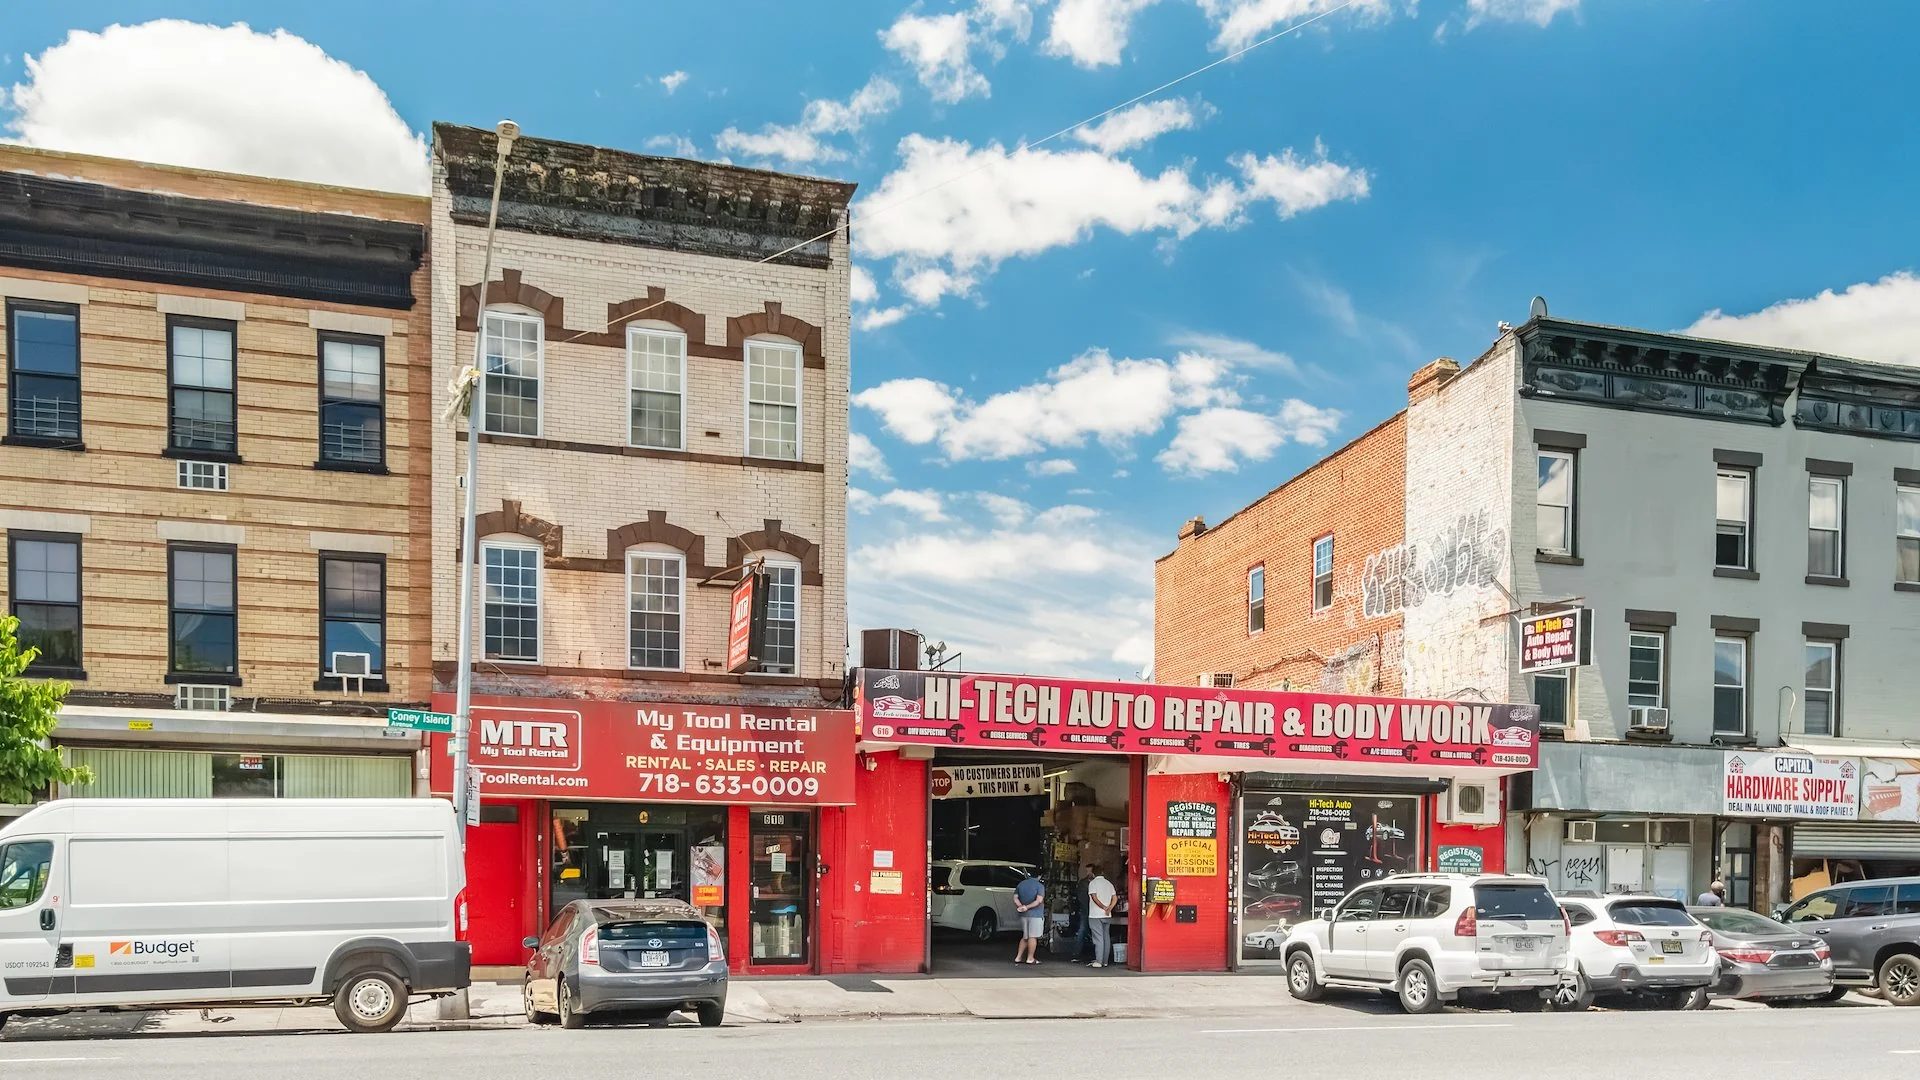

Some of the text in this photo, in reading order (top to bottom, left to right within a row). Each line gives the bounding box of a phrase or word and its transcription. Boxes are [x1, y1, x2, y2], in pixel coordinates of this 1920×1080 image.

[735, 595, 749, 624] MTR
[1526, 629, 1571, 647] Auto Repair
[1524, 642, 1573, 661] & Body Work
[923, 676, 1061, 725] HI-TECH
[1067, 688, 1155, 730] AUTO
[1163, 696, 1275, 735] REPAIR
[1282, 707, 1306, 736] &
[1312, 703, 1395, 740] BODY
[1400, 705, 1491, 744] WORK
[391, 711, 450, 725] Coney Island
[636, 709, 817, 732] My Tool Rental
[480, 719, 568, 747] MTR
[919, 728, 947, 736] INSPECTION
[1006, 732, 1028, 740] SERVICES
[650, 733, 804, 755] & Equipment
[1070, 734, 1107, 744] OIL CHANGE
[1149, 738, 1185, 747] SUSPENSIONS
[1233, 741, 1250, 749] TIRES
[480, 746, 569, 758] My Tool Rental
[1370, 747, 1402, 757] A/C SERVICES
[626, 755, 827, 774] RENTAL SALES REPAIR
[1776, 758, 1812, 773] CAPITAL
[954, 766, 1041, 781] NO CUSTOMERS BEYOND
[978, 781, 1019, 794] THIS POINT
[1727, 774, 1799, 801] HARDWARE
[1802, 777, 1847, 803] SUPPLY
[1169, 802, 1216, 815] REGISTERED
[1309, 799, 1352, 809] Hi-Tech Auto
[1728, 802, 1853, 816] DEAL IN ALL KIND OF WALL & ROOF PANELS
[763, 814, 785, 825] 610
[1309, 809, 1351, 817] 718-436-0005
[1191, 821, 1216, 829] VEHICLE
[1171, 828, 1212, 837] REPAIR SHOP
[1171, 840, 1212, 851] OFFICIAL
[1438, 847, 1482, 862] REGISTERED
[1168, 858, 1215, 866] EMISSIONS
[134, 940, 195, 957] Budget
